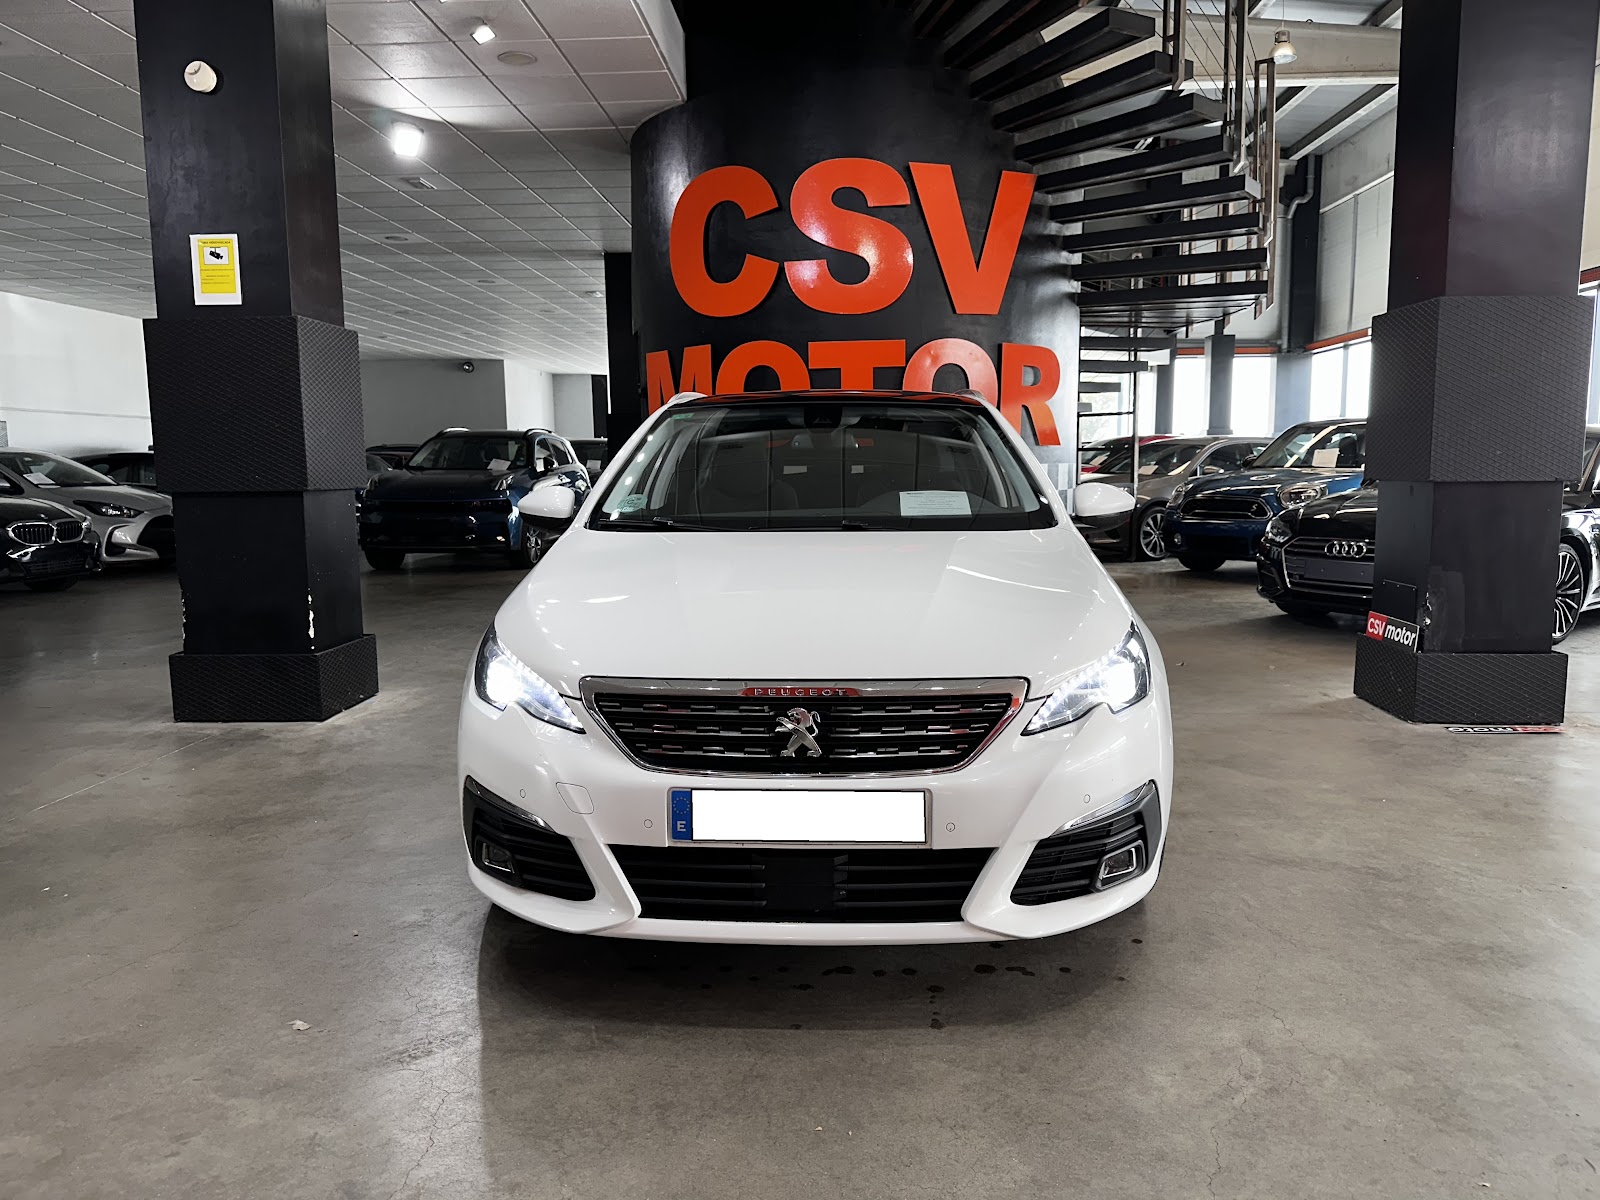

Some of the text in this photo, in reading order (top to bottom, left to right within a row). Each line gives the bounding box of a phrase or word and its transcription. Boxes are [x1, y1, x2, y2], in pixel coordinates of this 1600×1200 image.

[669, 157, 1038, 318] CSV
[1367, 617, 1417, 647] CSV motor
[754, 688, 846, 696] PEUGEOT
[676, 820, 687, 832] E
